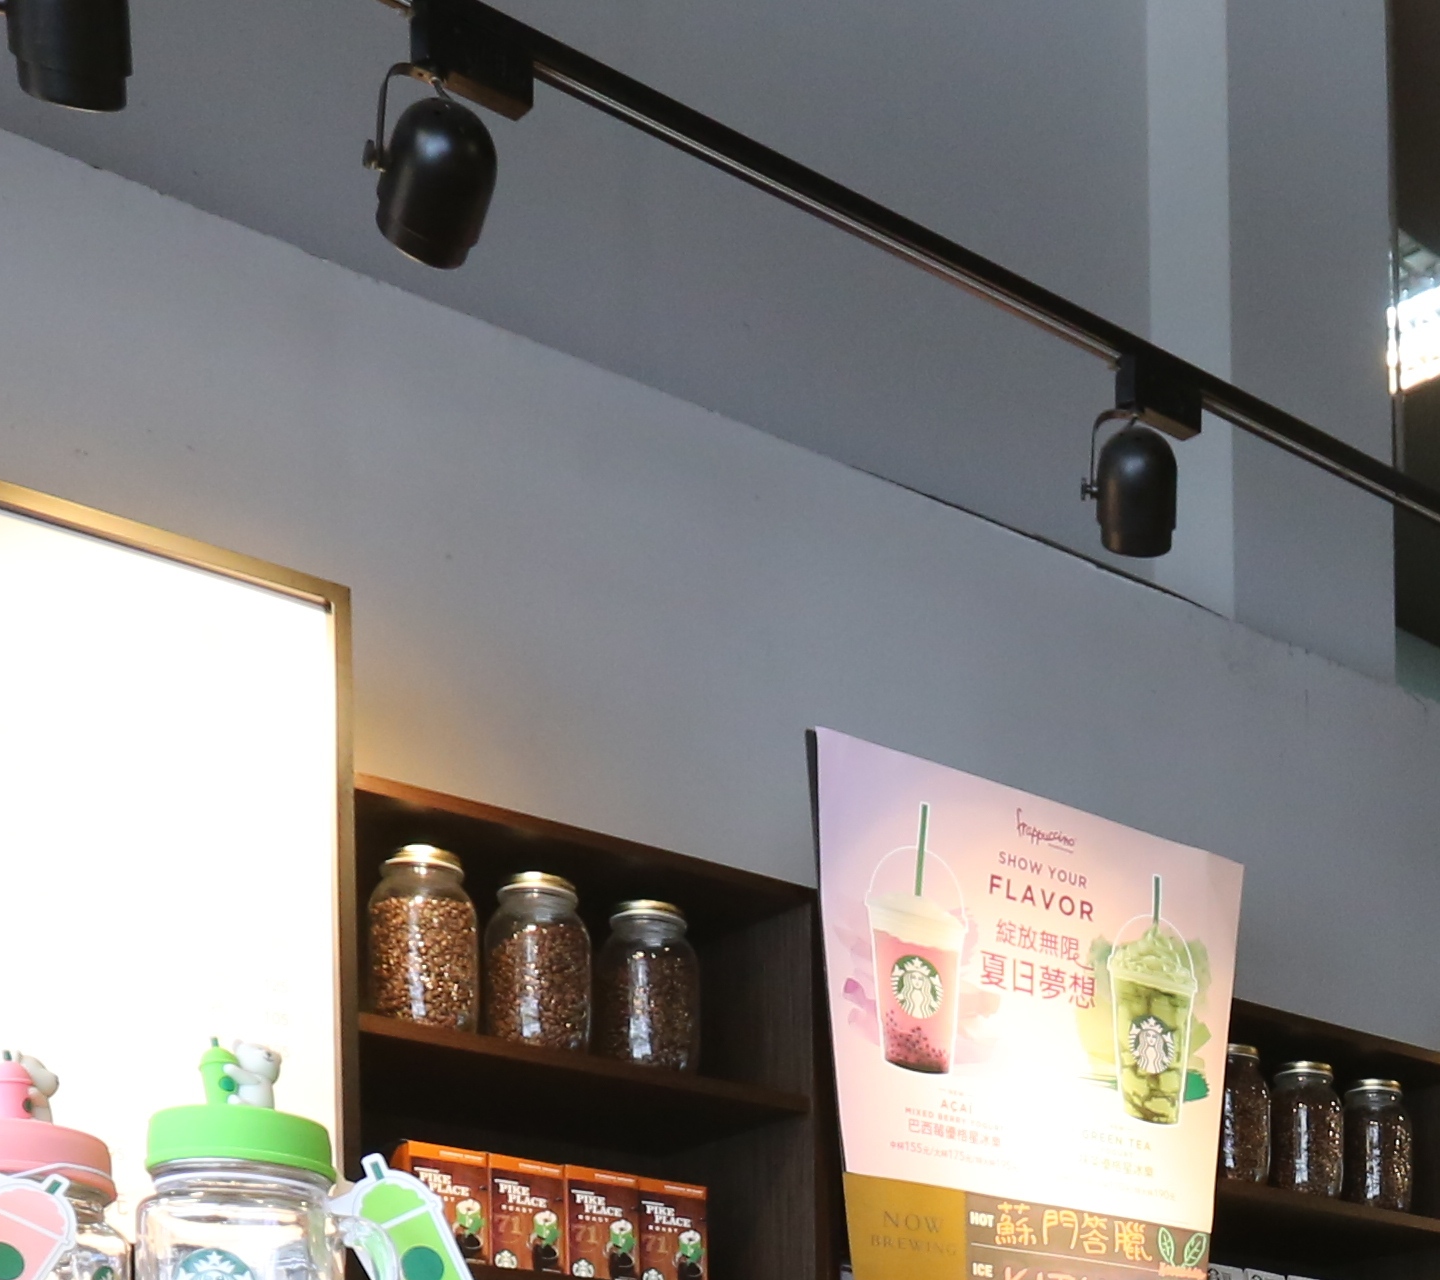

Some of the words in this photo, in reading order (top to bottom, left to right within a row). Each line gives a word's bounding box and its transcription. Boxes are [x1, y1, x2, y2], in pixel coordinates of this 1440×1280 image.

[998, 850, 1044, 876] SHOW
[1047, 865, 1089, 890] YOUR
[988, 873, 1095, 923] FLAVOR
[995, 918, 1090, 967] 綻放無限
[980, 949, 1096, 1010] 夏日夢想
[1128, 1138, 1152, 1152] TEA
[419, 1169, 452, 1185] PIKE
[429, 1182, 472, 1199] PLACE
[499, 1181, 531, 1197] PIKE
[508, 1193, 549, 1210] PLACE
[576, 1191, 607, 1207] PIKE
[584, 1203, 624, 1219] PLACE
[645, 1201, 676, 1218] PIKE
[653, 1213, 693, 1229] PLACE
[880, 1208, 944, 1235] NOW
[968, 1210, 995, 1229] HOT
[869, 1233, 958, 1258] BREWING
[972, 1261, 995, 1279] ICE
